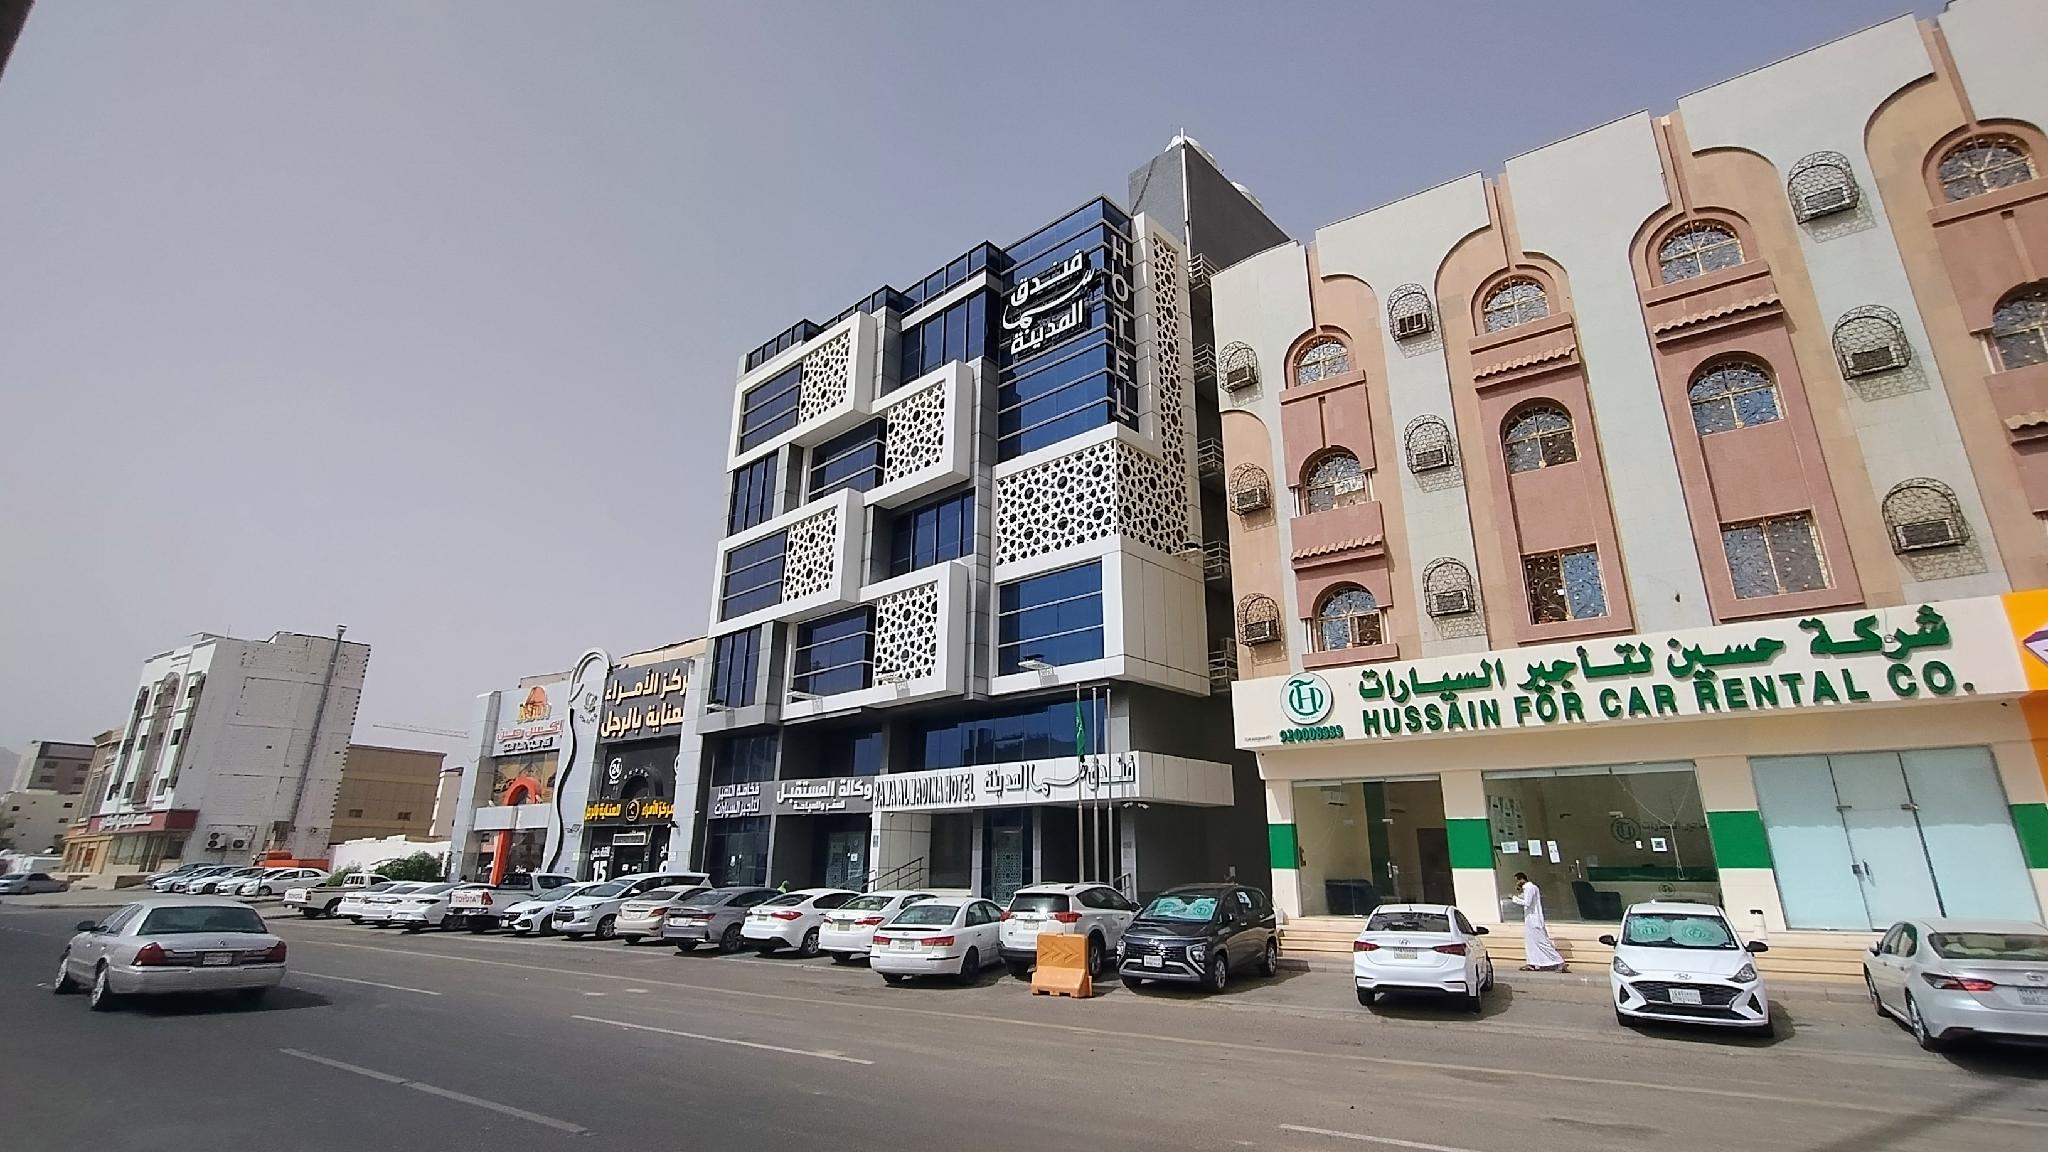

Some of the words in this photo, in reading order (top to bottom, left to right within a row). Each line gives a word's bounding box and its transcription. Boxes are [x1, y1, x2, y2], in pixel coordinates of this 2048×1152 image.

[1011, 249, 1083, 307] فندق
[1002, 268, 1095, 330] سما
[1010, 299, 1083, 355] المدينة
[1111, 234, 1130, 421] HOTEL
[1799, 605, 1952, 660] شركة
[1667, 636, 1785, 681] حسين
[604, 669, 661, 706] الأمراء
[1359, 659, 1506, 703] السيارات
[1362, 698, 1502, 736] HUSSAIN
[1514, 689, 1586, 724] FOR
[1599, 683, 1678, 721] CAR
[1694, 668, 1871, 712] RENTAL
[1886, 660, 1976, 696] CO.
[601, 706, 643, 738] بالرجل
[838, 779, 874, 801] وكالة
[944, 773, 976, 804] HOTEL
[984, 764, 1030, 798] المدينة
[1087, 755, 1137, 792] فندق
[776, 780, 836, 805] المستقبل
[592, 860, 608, 883] 15
[455, 895, 477, 903] TOYOTA
